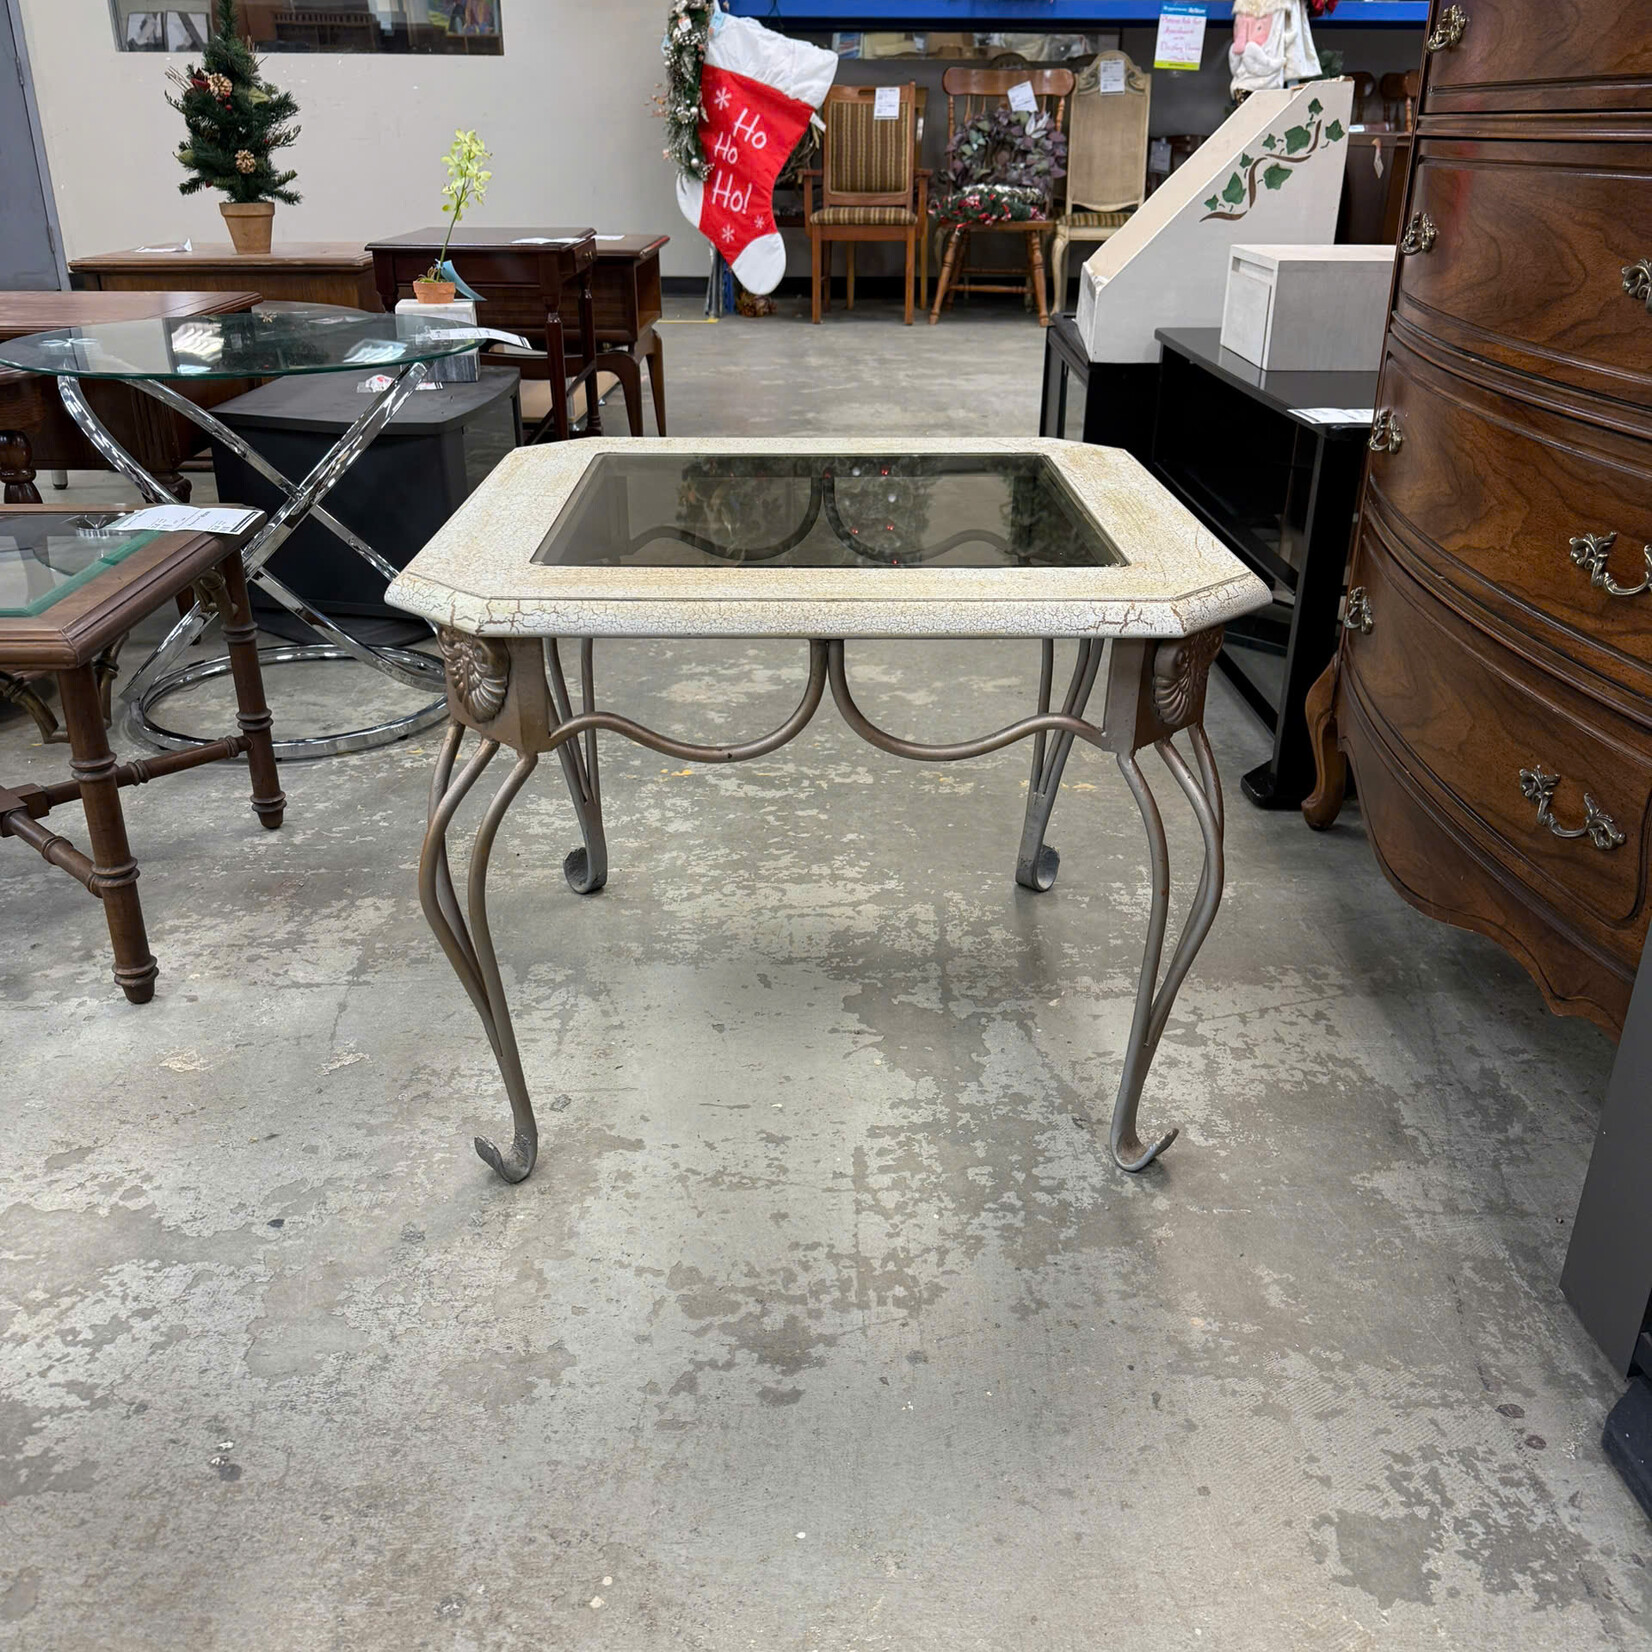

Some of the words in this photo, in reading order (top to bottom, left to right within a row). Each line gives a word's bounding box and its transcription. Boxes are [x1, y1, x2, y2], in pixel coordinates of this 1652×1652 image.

[714, 131, 738, 164] Ho
[733, 107, 767, 149] Ho
[712, 170, 752, 214] Ho!
